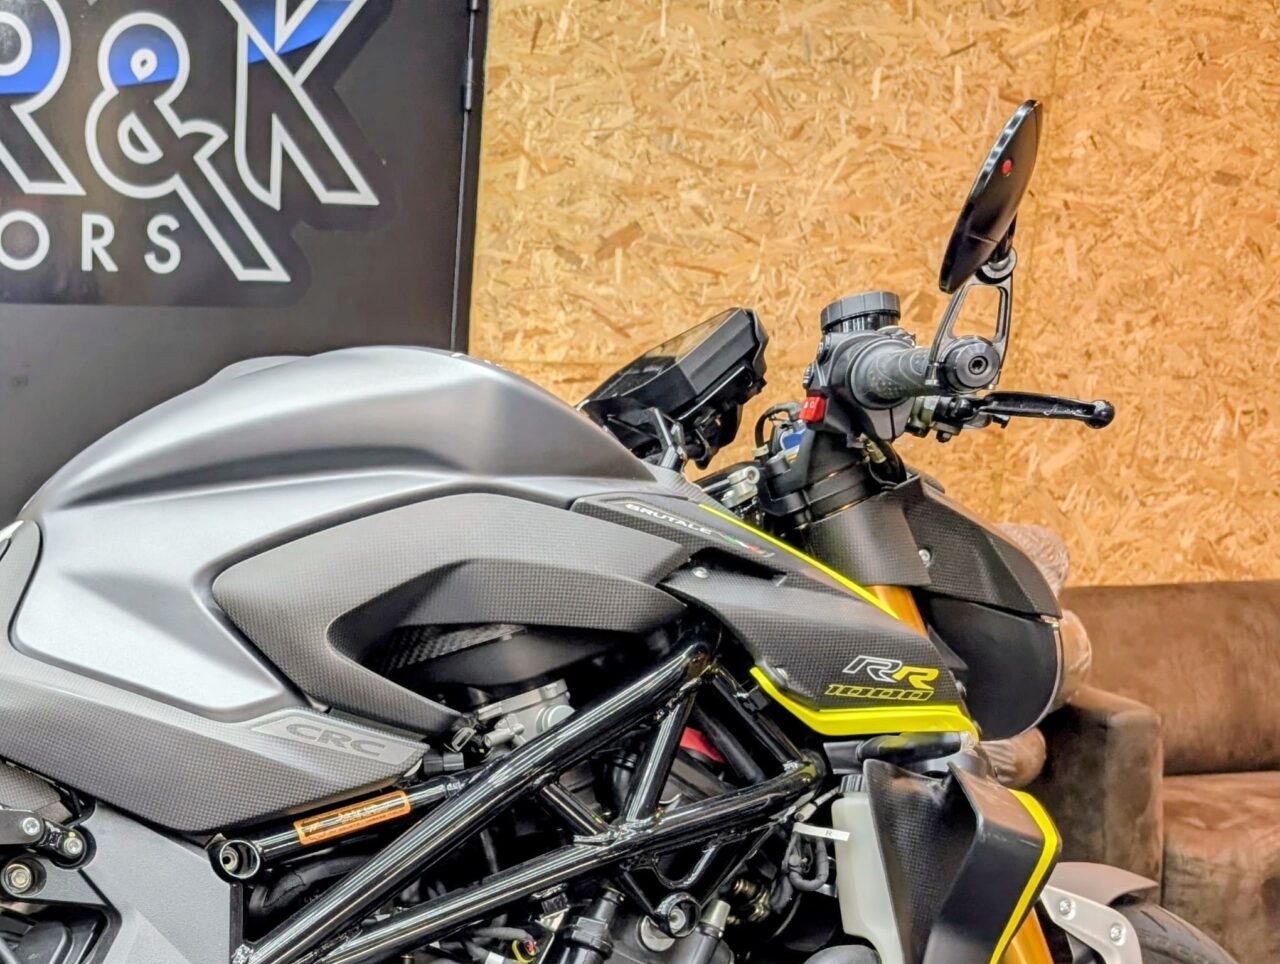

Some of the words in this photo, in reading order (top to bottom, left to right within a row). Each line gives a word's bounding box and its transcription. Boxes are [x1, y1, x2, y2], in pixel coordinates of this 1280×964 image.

[624, 502, 713, 536] BRUTALE
[841, 654, 939, 690] RR
[823, 684, 934, 702] 1000
[285, 723, 387, 757] CRC
